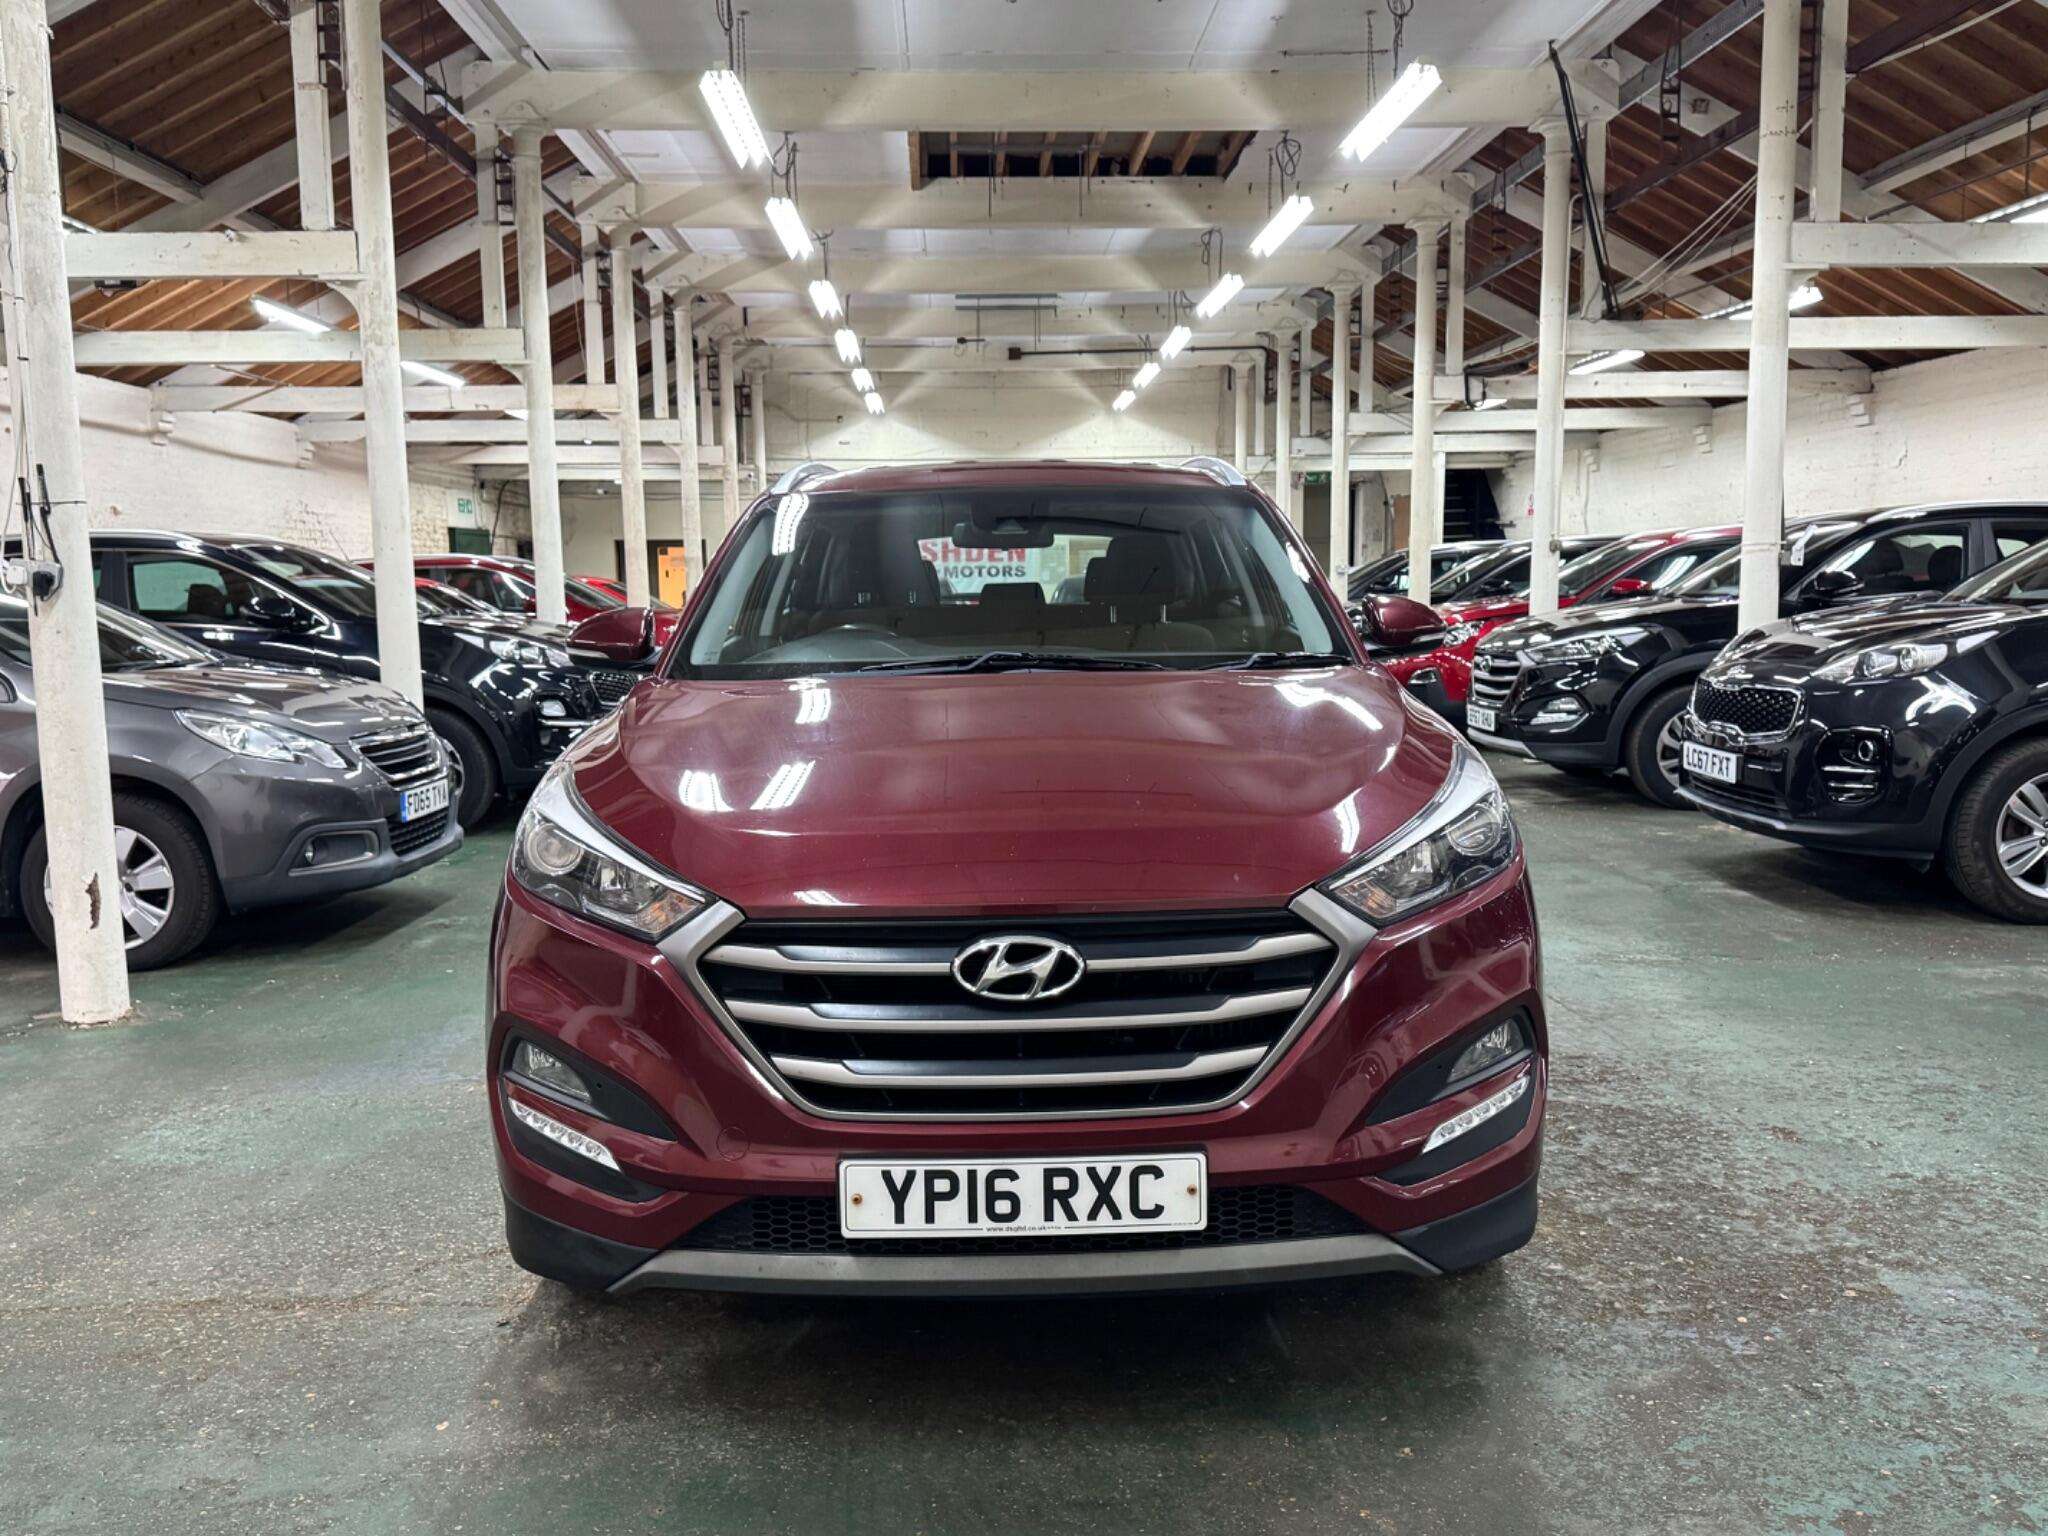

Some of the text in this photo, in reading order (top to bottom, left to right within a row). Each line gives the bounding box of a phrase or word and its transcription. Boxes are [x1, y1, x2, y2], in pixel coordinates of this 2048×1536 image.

[944, 565, 1026, 579] MOTORS
[1686, 746, 1731, 778] LC67 FXT
[407, 788, 431, 817] FD65
[880, 1164, 1165, 1225] YP16 RXC
